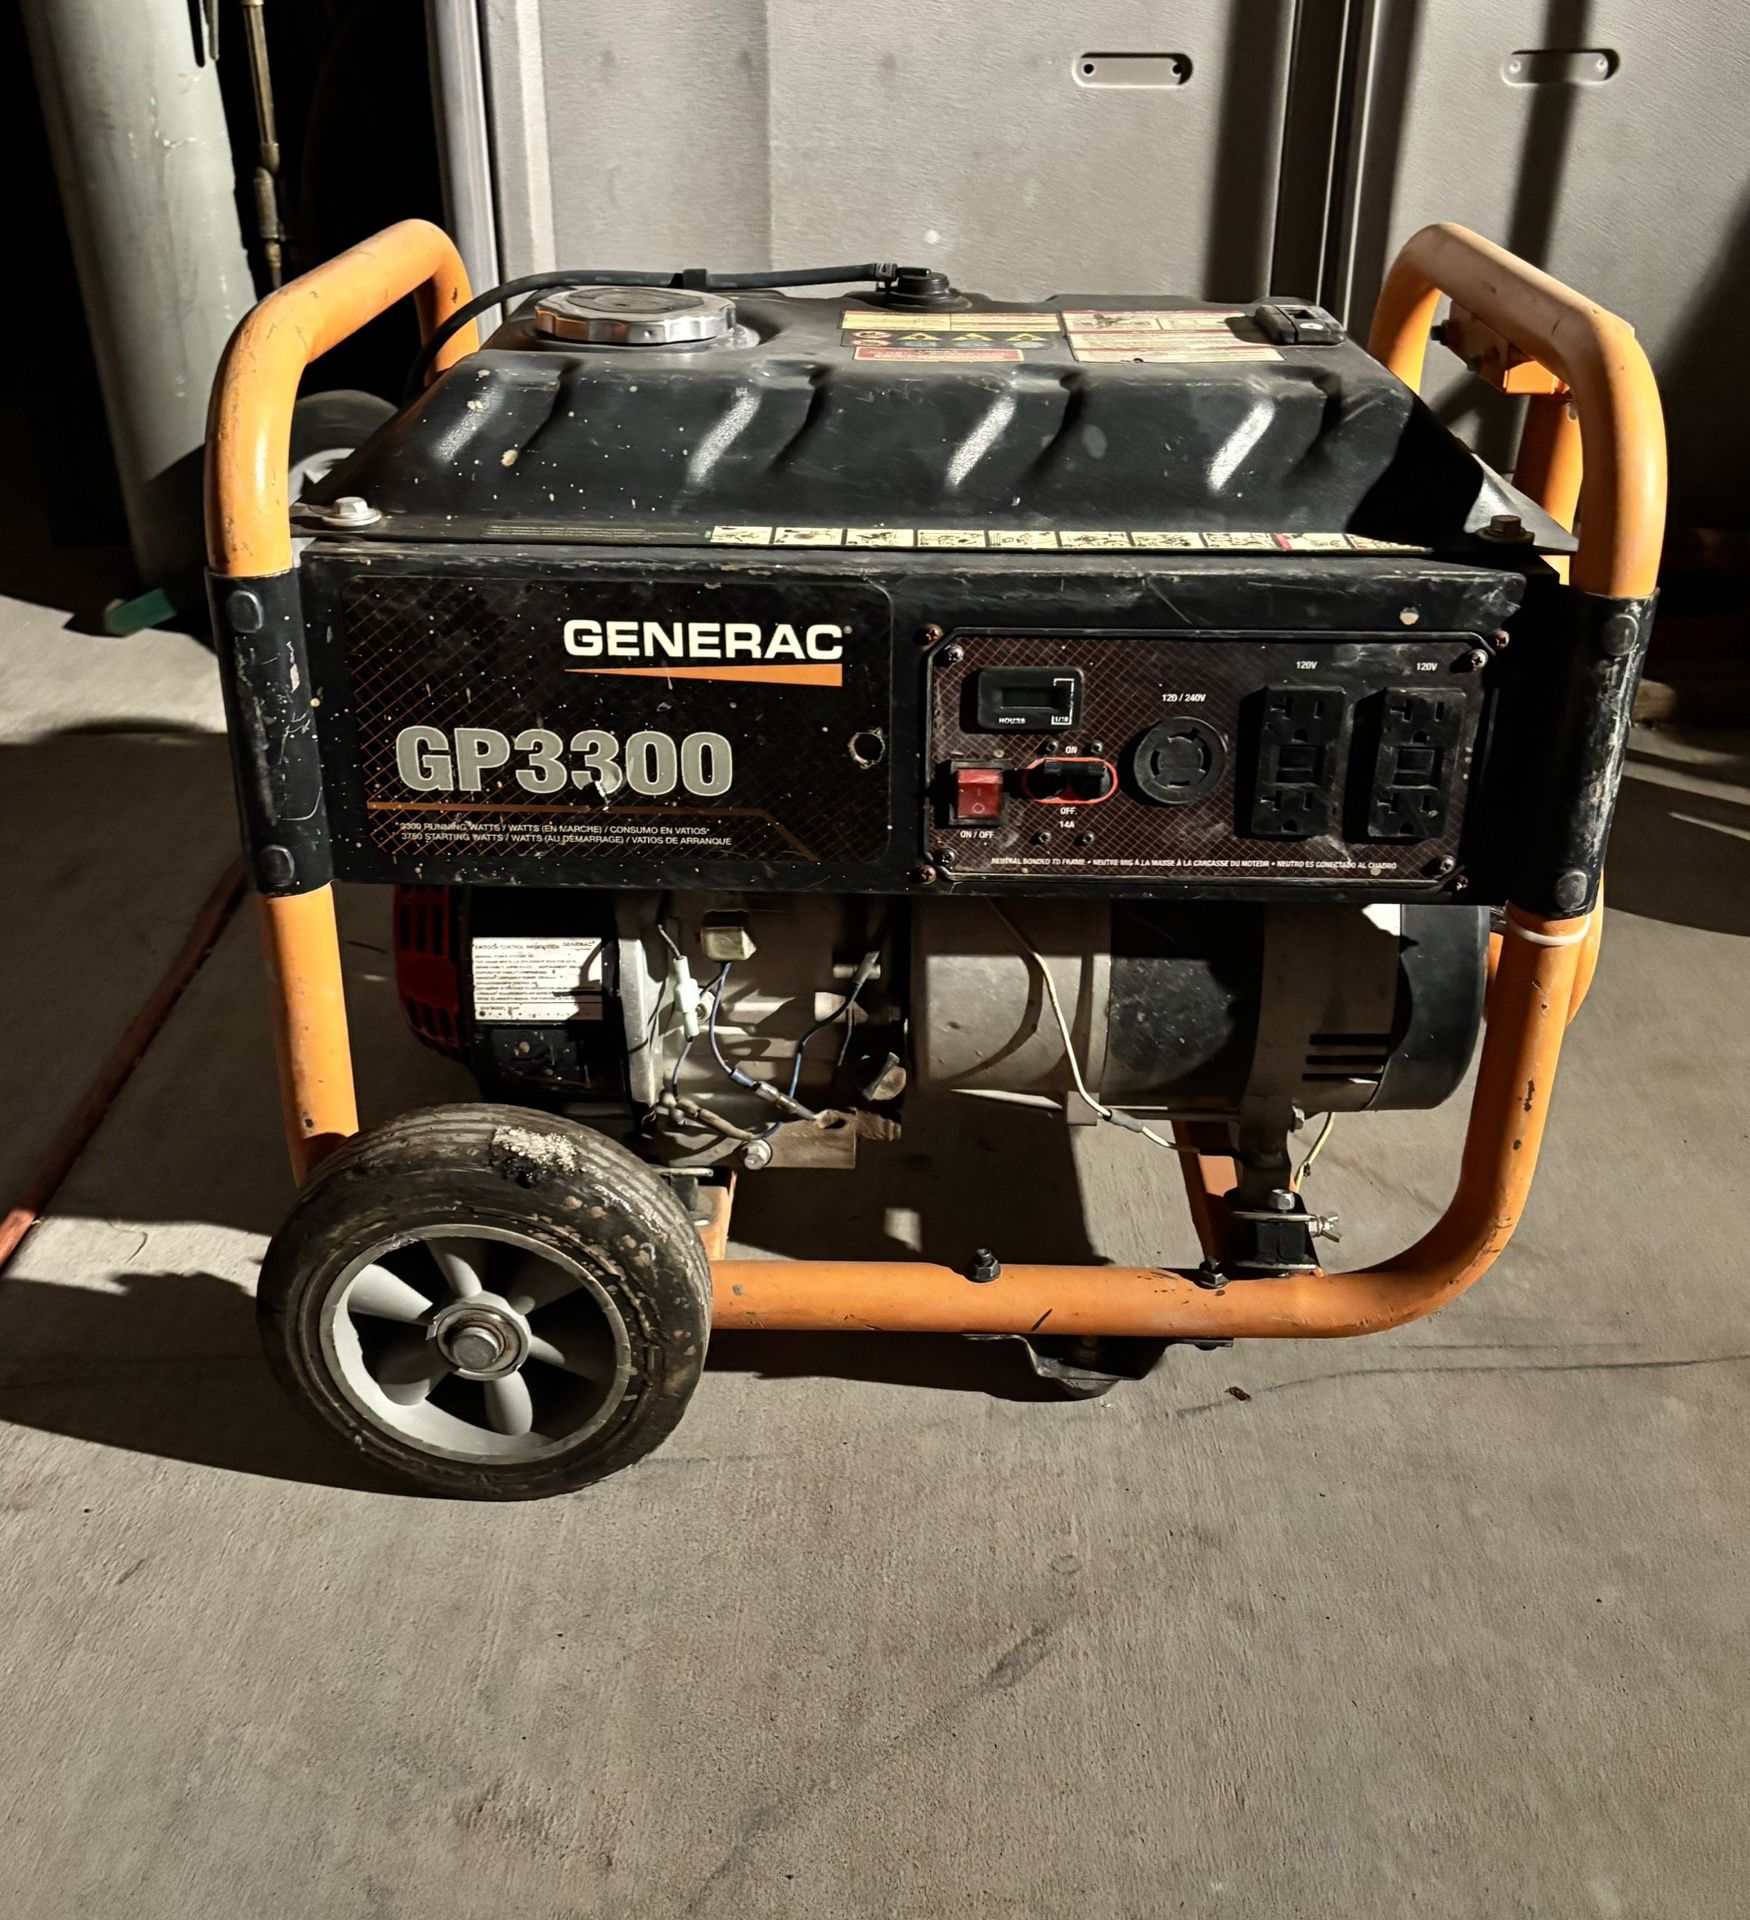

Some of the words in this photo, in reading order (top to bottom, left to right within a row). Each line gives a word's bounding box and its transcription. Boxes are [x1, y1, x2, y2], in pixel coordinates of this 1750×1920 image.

[563, 619, 843, 660] GENERAC
[1296, 661, 1318, 670] 120V
[1416, 662, 1438, 671] 120V
[1162, 694, 1178, 702] 120
[1185, 694, 1206, 702] 240V
[999, 717, 1026, 725] HOURS
[396, 725, 733, 796] GP3300
[400, 823, 422, 831] 3300
[424, 822, 467, 831] RUNNING
[469, 823, 501, 832] WATTS
[508, 824, 540, 832] WATTS
[541, 824, 557, 833] (EN
[559, 825, 602, 834] MARCHE)
[609, 826, 658, 834] CONSUMO
[660, 827, 673, 835] EN
[425, 833, 470, 841] STARTING
[472, 834, 503, 842] WATTS
[511, 834, 543, 842] WATTS
[632, 836, 664, 845] VATIOS
[666, 837, 678, 845] DE
[680, 837, 732, 846] ARRANQUE
